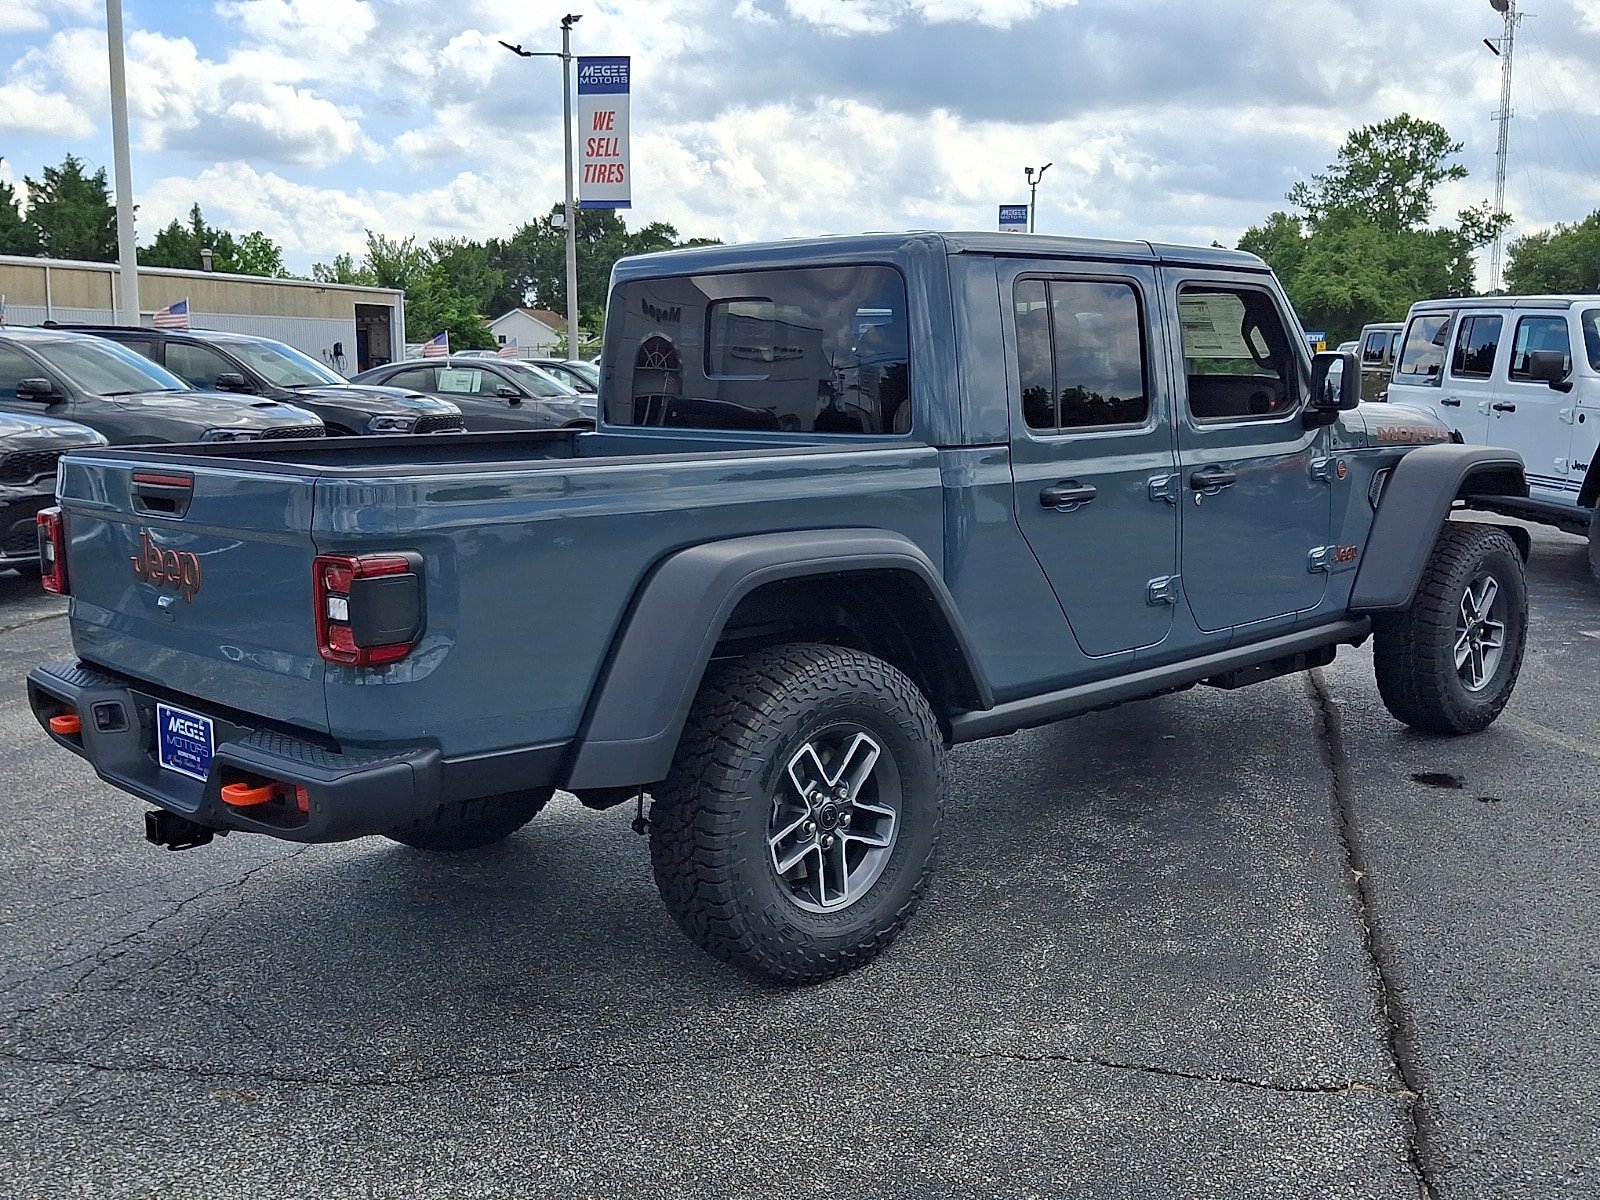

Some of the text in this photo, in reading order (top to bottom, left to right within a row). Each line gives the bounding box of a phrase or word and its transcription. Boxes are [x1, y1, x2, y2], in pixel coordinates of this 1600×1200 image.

[579, 76, 628, 84] MOTORS
[580, 65, 628, 77] MEGEE
[593, 111, 615, 131] WE
[586, 137, 619, 157] SELL
[584, 163, 624, 184] TIRES
[1334, 545, 1357, 563] Jeep
[130, 531, 200, 603] Jeep
[168, 716, 206, 743] MEGEE
[166, 734, 209, 758] MOTORS
